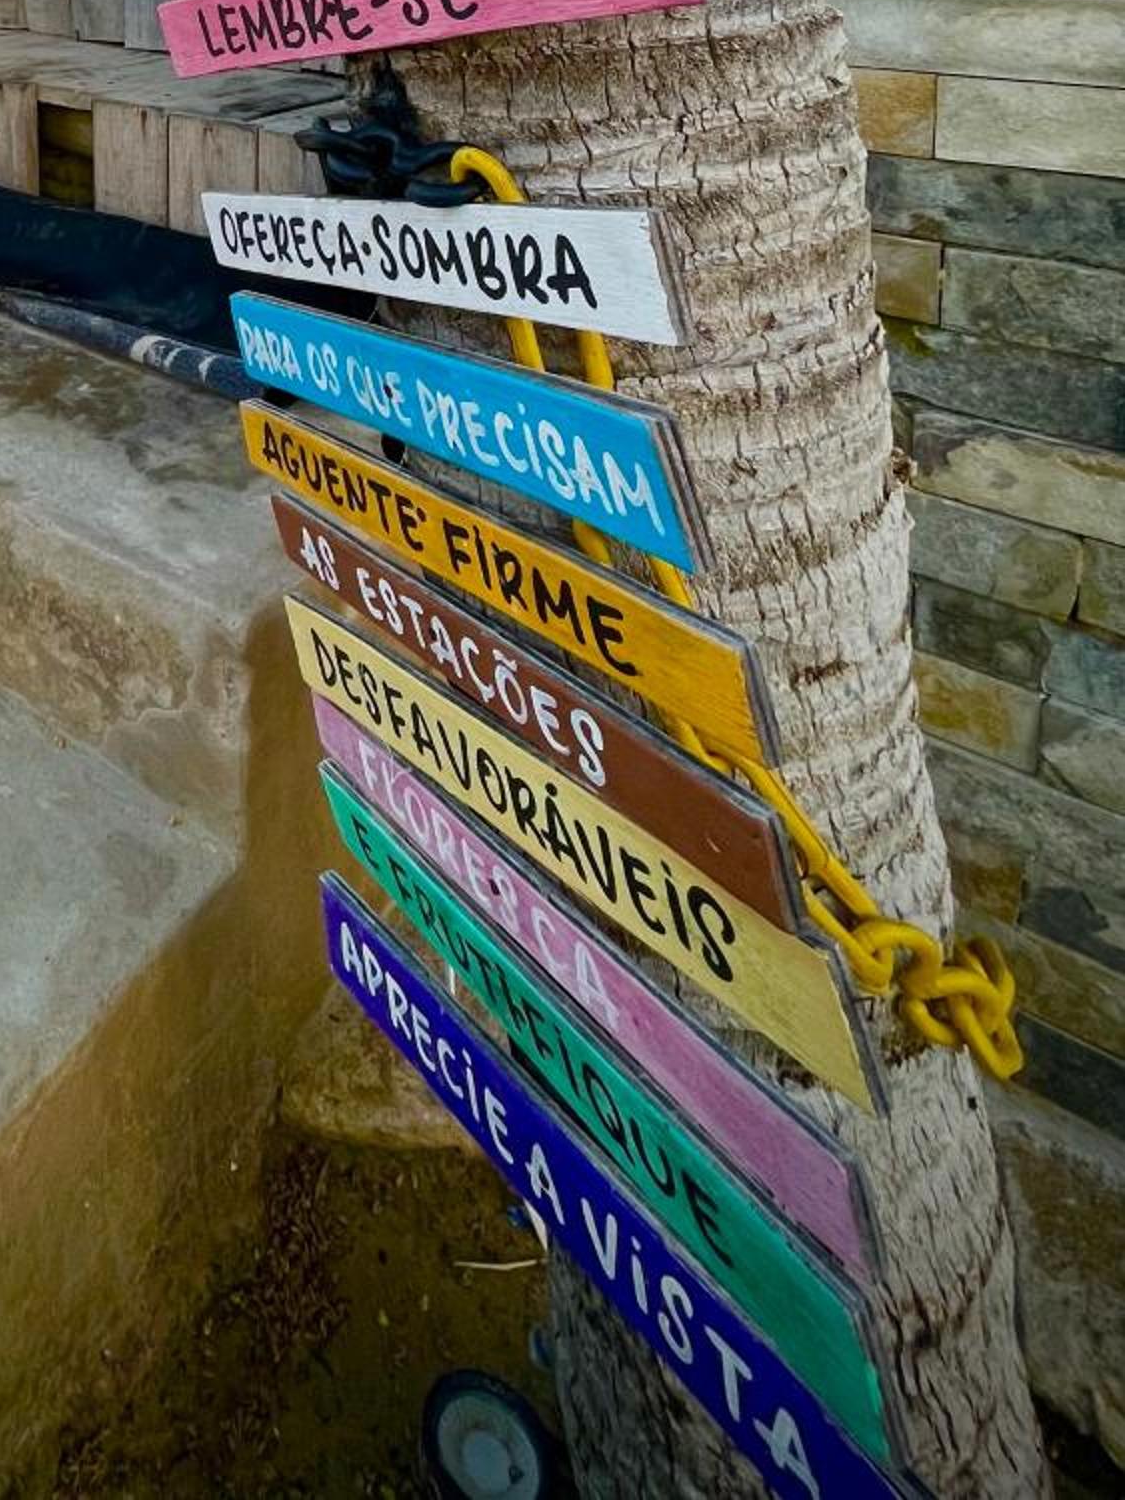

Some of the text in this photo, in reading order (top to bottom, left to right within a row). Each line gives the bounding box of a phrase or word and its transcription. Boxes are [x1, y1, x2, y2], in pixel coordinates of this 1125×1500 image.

[219, 207, 598, 308] OFEREÇA SOMBRA
[237, 317, 303, 384] PARA
[306, 342, 339, 397] OS
[346, 354, 412, 427] QUE
[262, 420, 424, 551] AGUENTE
[301, 527, 606, 787] AS ESTAÇÕES
[352, 815, 379, 870] E
[525, 1143, 566, 1226] A
